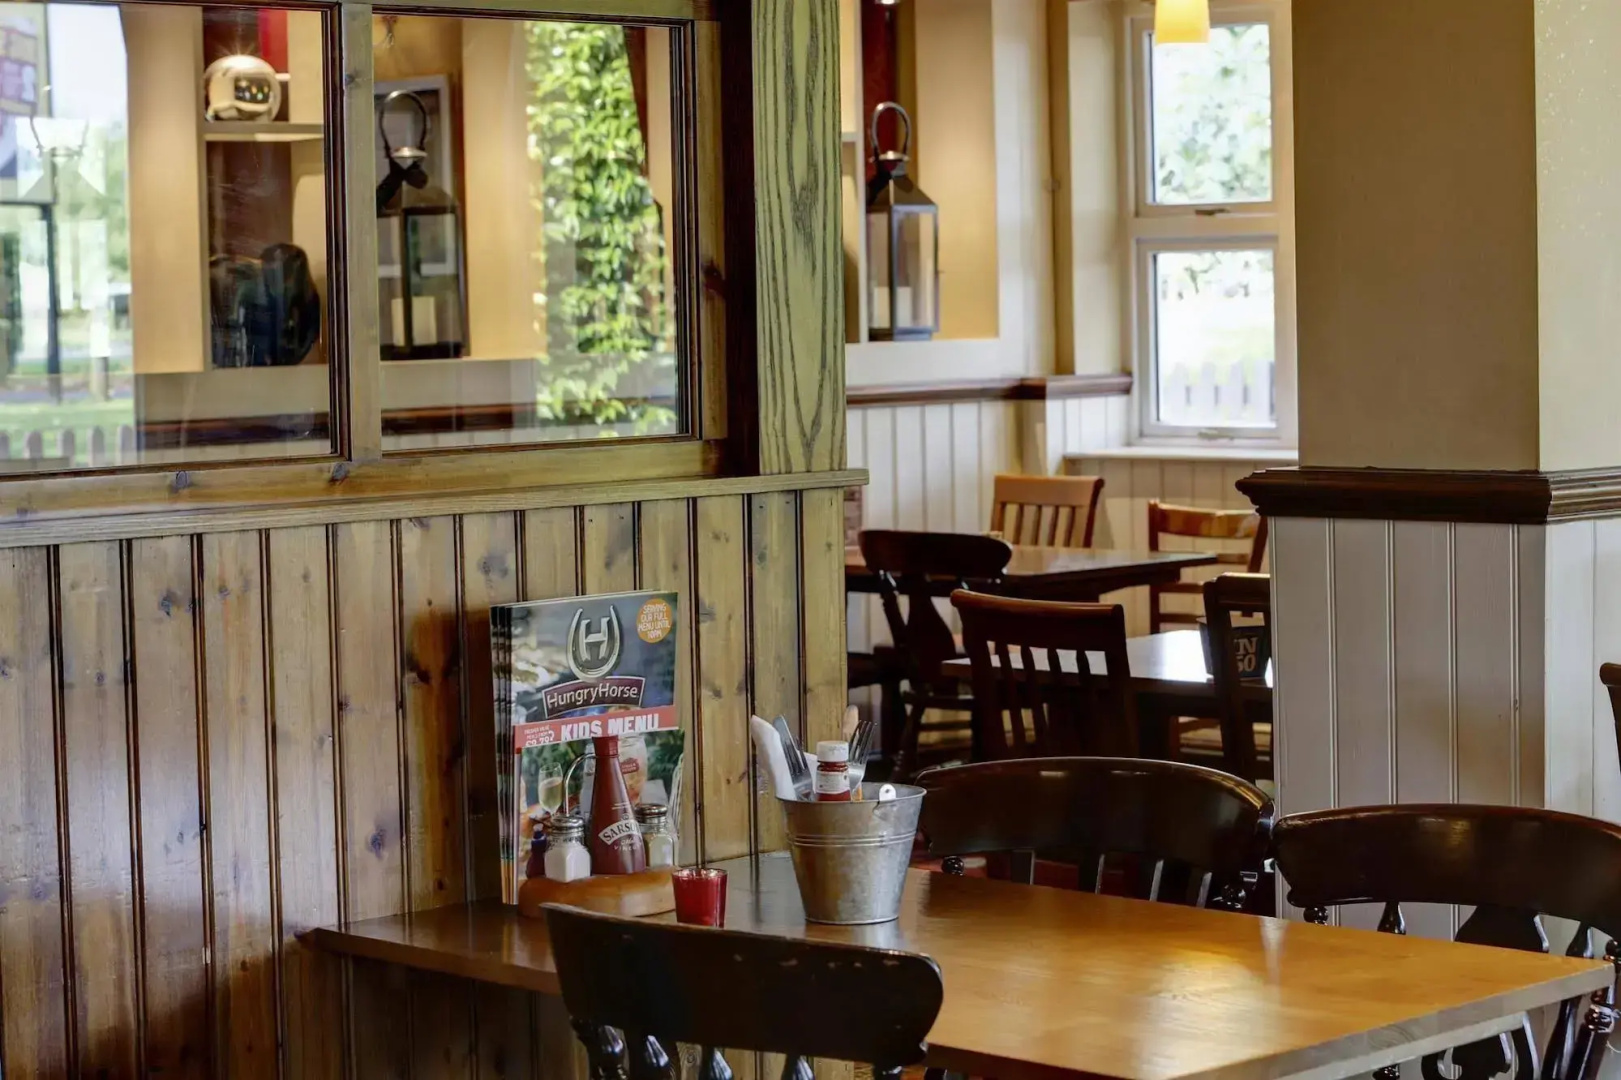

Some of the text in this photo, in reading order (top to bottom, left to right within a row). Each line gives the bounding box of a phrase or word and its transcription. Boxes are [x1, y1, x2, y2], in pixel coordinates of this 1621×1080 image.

[640, 611, 668, 623] OUR FULL
[560, 713, 659, 742] KIDS MENU
